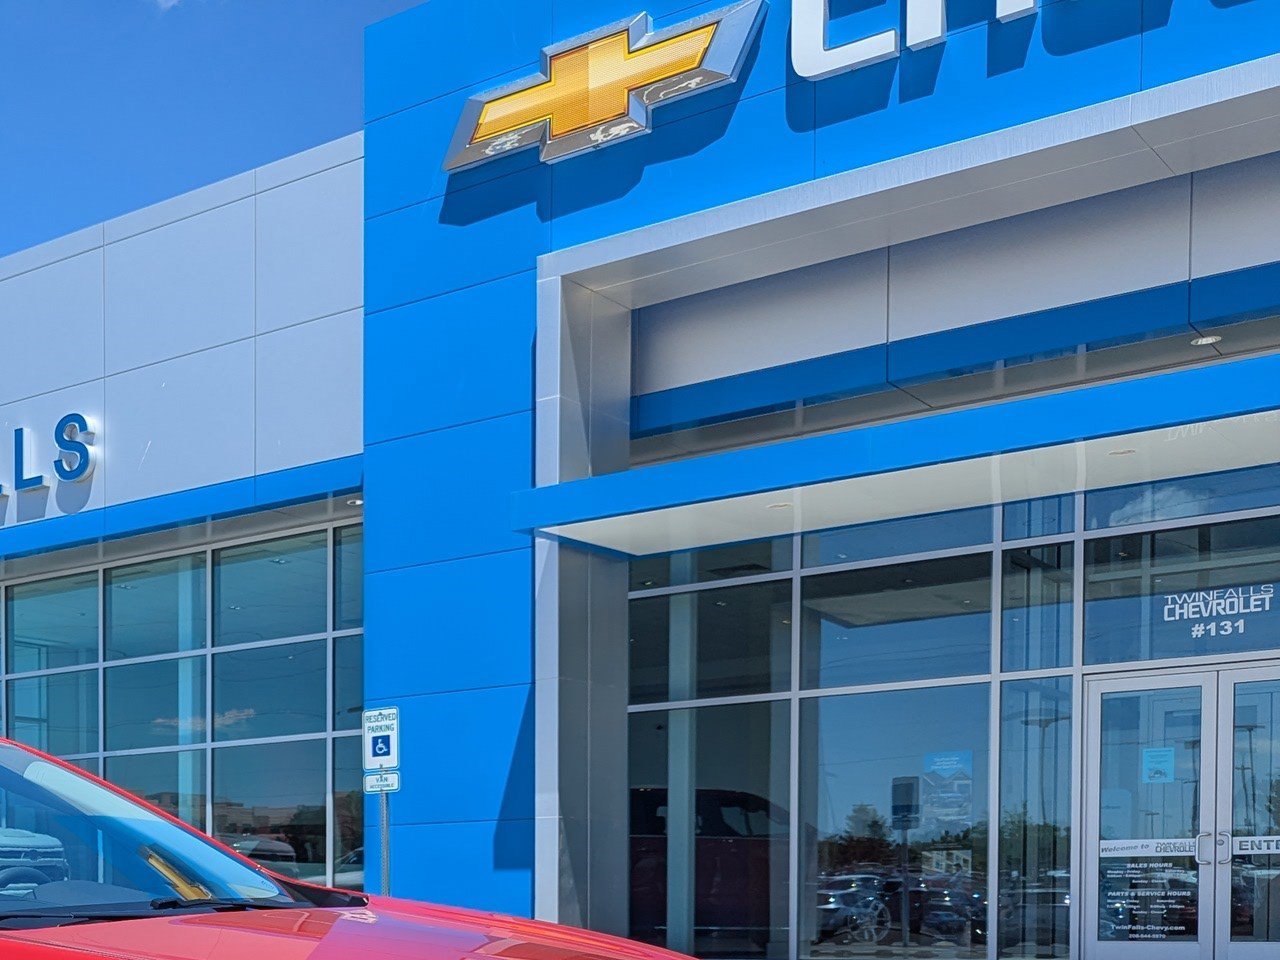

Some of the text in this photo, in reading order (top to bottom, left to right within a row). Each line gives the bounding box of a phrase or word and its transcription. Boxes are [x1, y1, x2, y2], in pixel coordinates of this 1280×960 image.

[1164, 584, 1274, 604] TWINFALLS
[1163, 594, 1274, 622] CHEVROLET
[1191, 619, 1245, 638] #131
[365, 712, 396, 723] RESERVED
[367, 723, 395, 734] PARKING
[1101, 844, 1139, 853] Welcome
[1111, 924, 1186, 932] TwinFalls-Chevy.com
